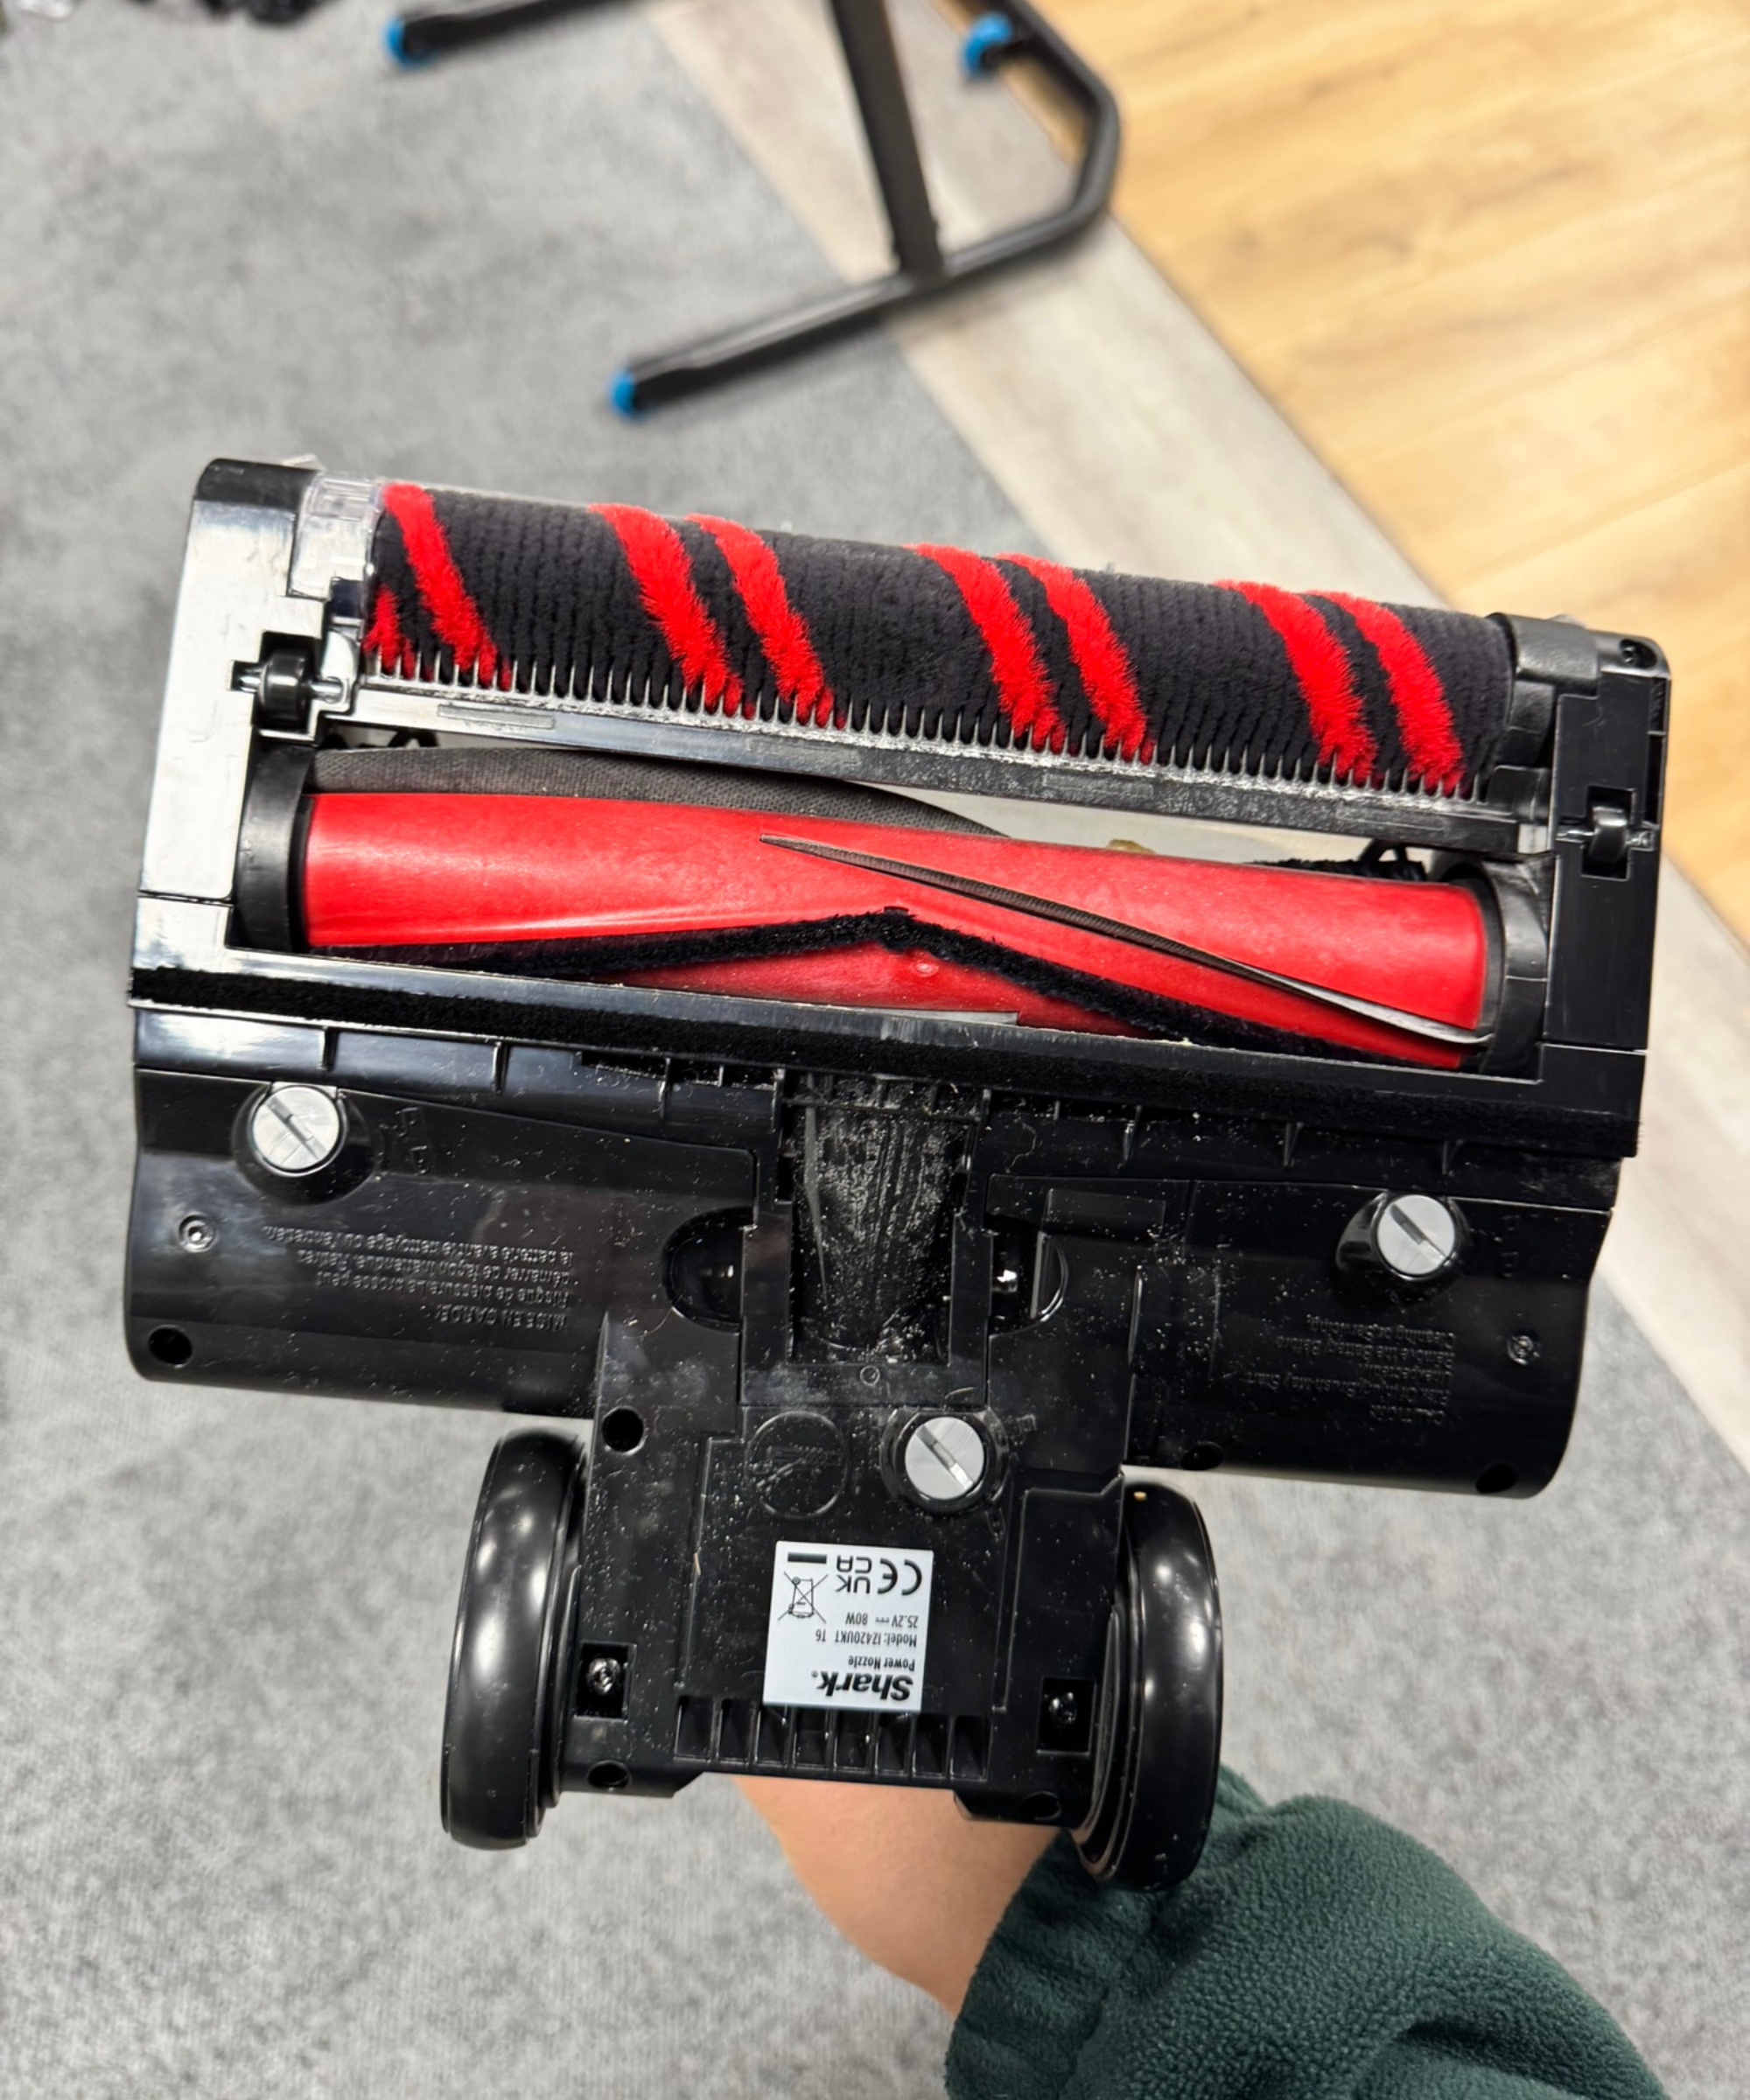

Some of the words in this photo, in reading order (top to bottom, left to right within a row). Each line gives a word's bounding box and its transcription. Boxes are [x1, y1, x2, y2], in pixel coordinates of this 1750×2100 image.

[496, 1286, 514, 1306] de
[836, 1555, 872, 1574] CA
[835, 1575, 871, 1594] UK
[845, 1612, 868, 1626] 80W
[891, 1614, 919, 1628] 25.2V
[816, 1629, 826, 1642] T6
[835, 1629, 881, 1645] IZ420UKT
[884, 1632, 917, 1648] Model:
[848, 1656, 881, 1670] Nozzle
[884, 1656, 915, 1671] Power
